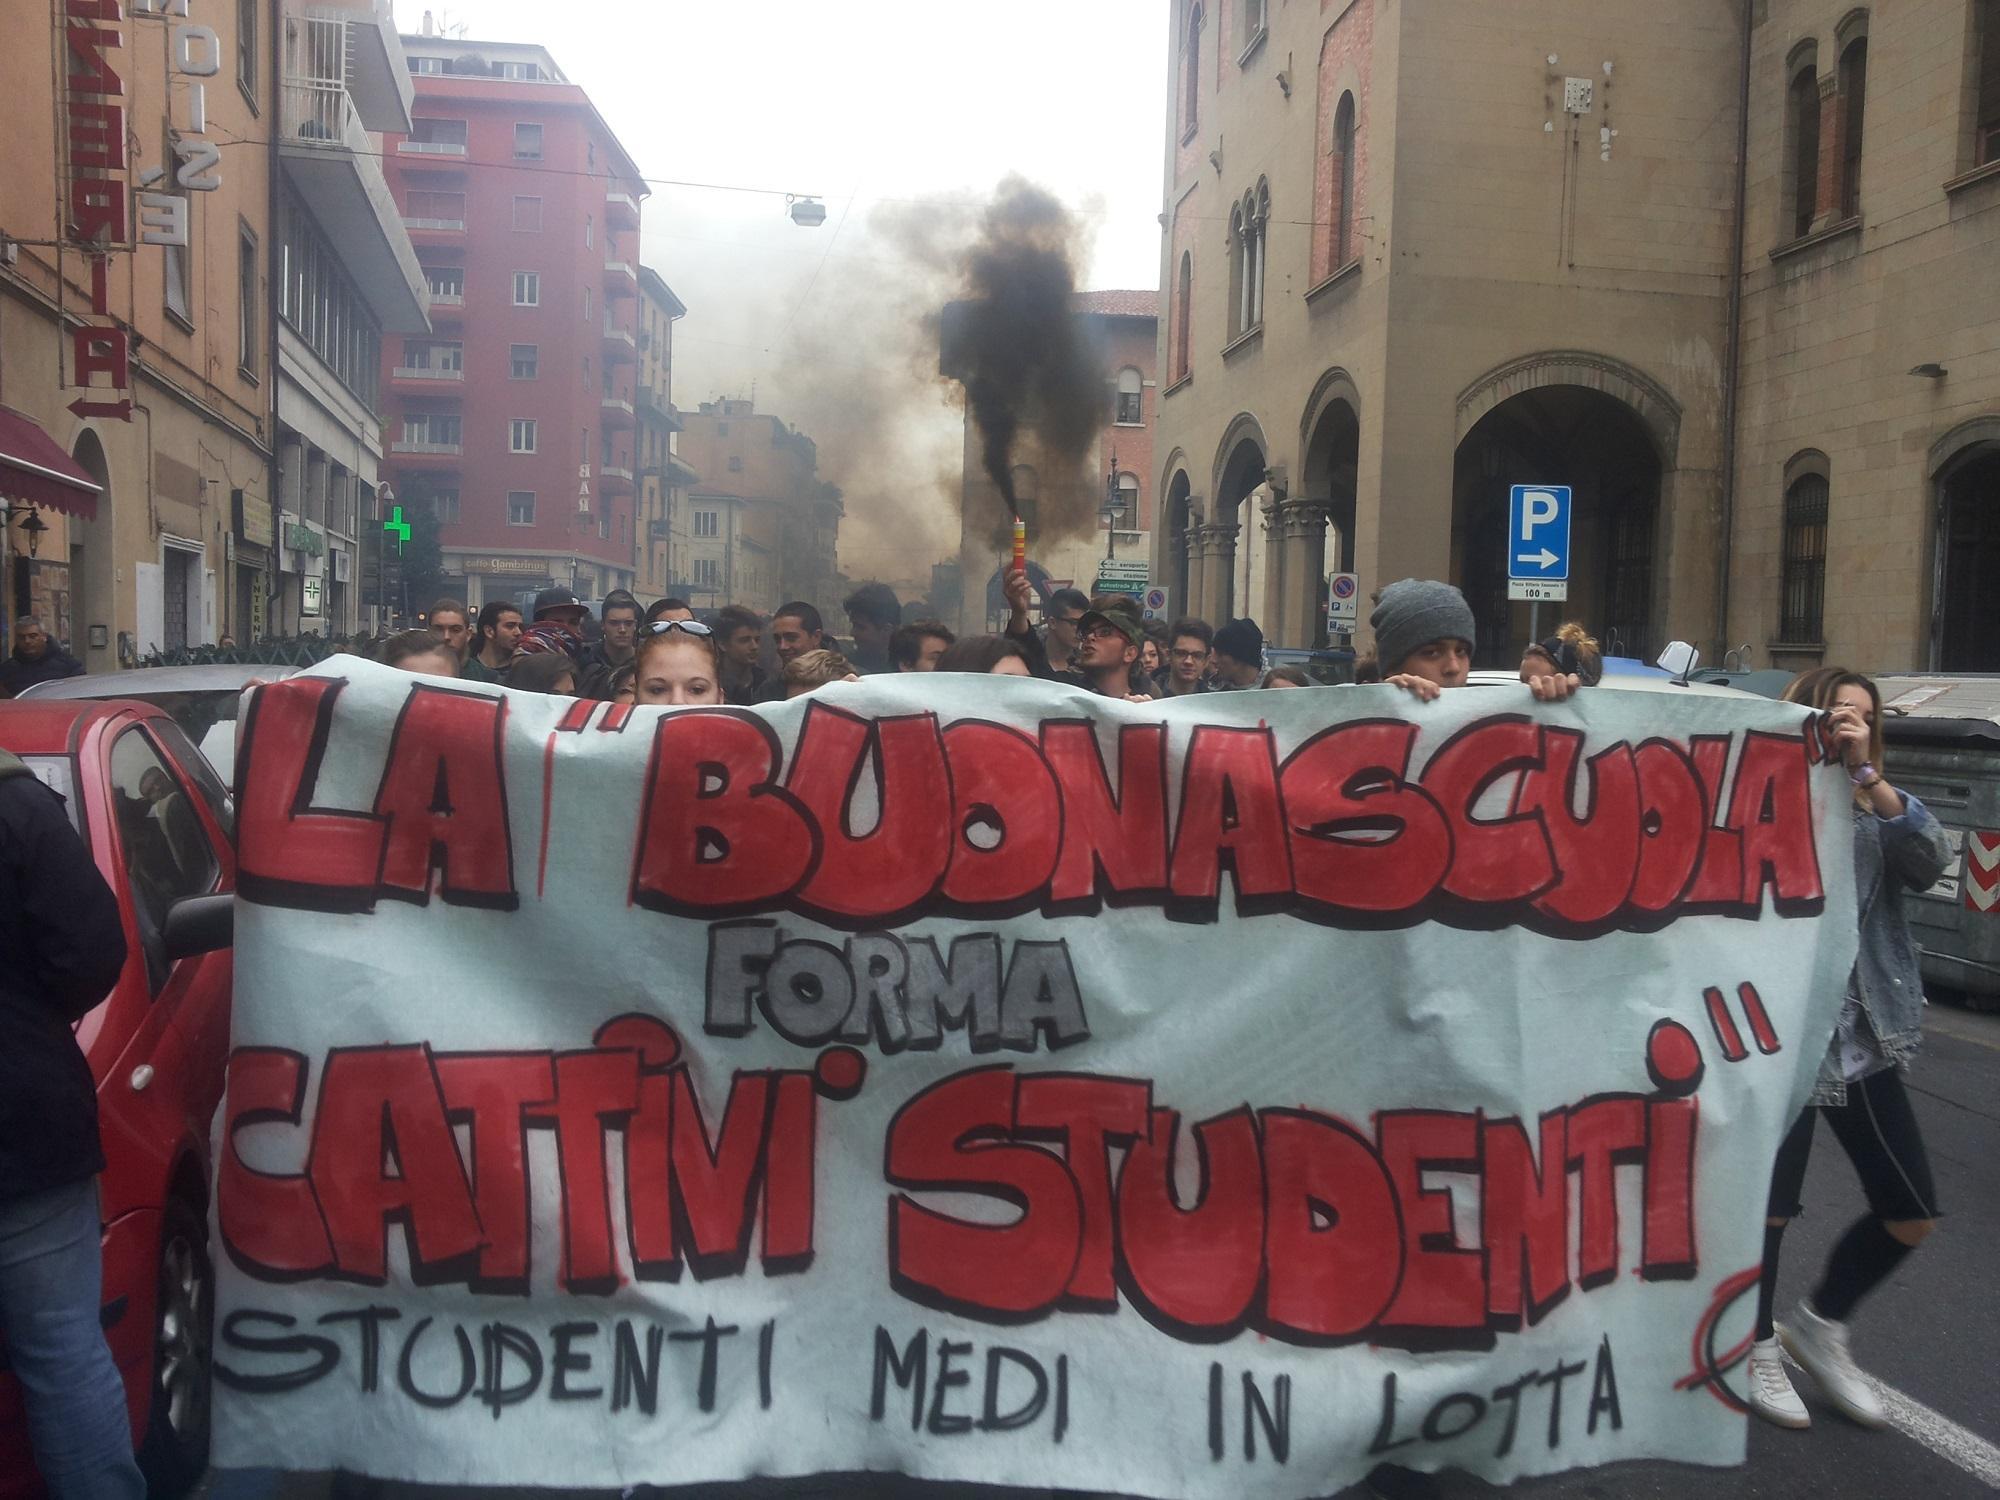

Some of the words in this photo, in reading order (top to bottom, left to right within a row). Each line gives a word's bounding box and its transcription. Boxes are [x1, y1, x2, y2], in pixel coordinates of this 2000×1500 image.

[1521, 491, 1558, 541] P
[1525, 589, 1540, 598] 100
[233, 676, 519, 914] LA
[704, 918, 1091, 1054] FORMA
[211, 1305, 776, 1419] STUDENTI
[870, 1325, 1068, 1443] MEDI
[1209, 1361, 1291, 1465] IN
[1368, 1332, 1622, 1458] LOTTA
